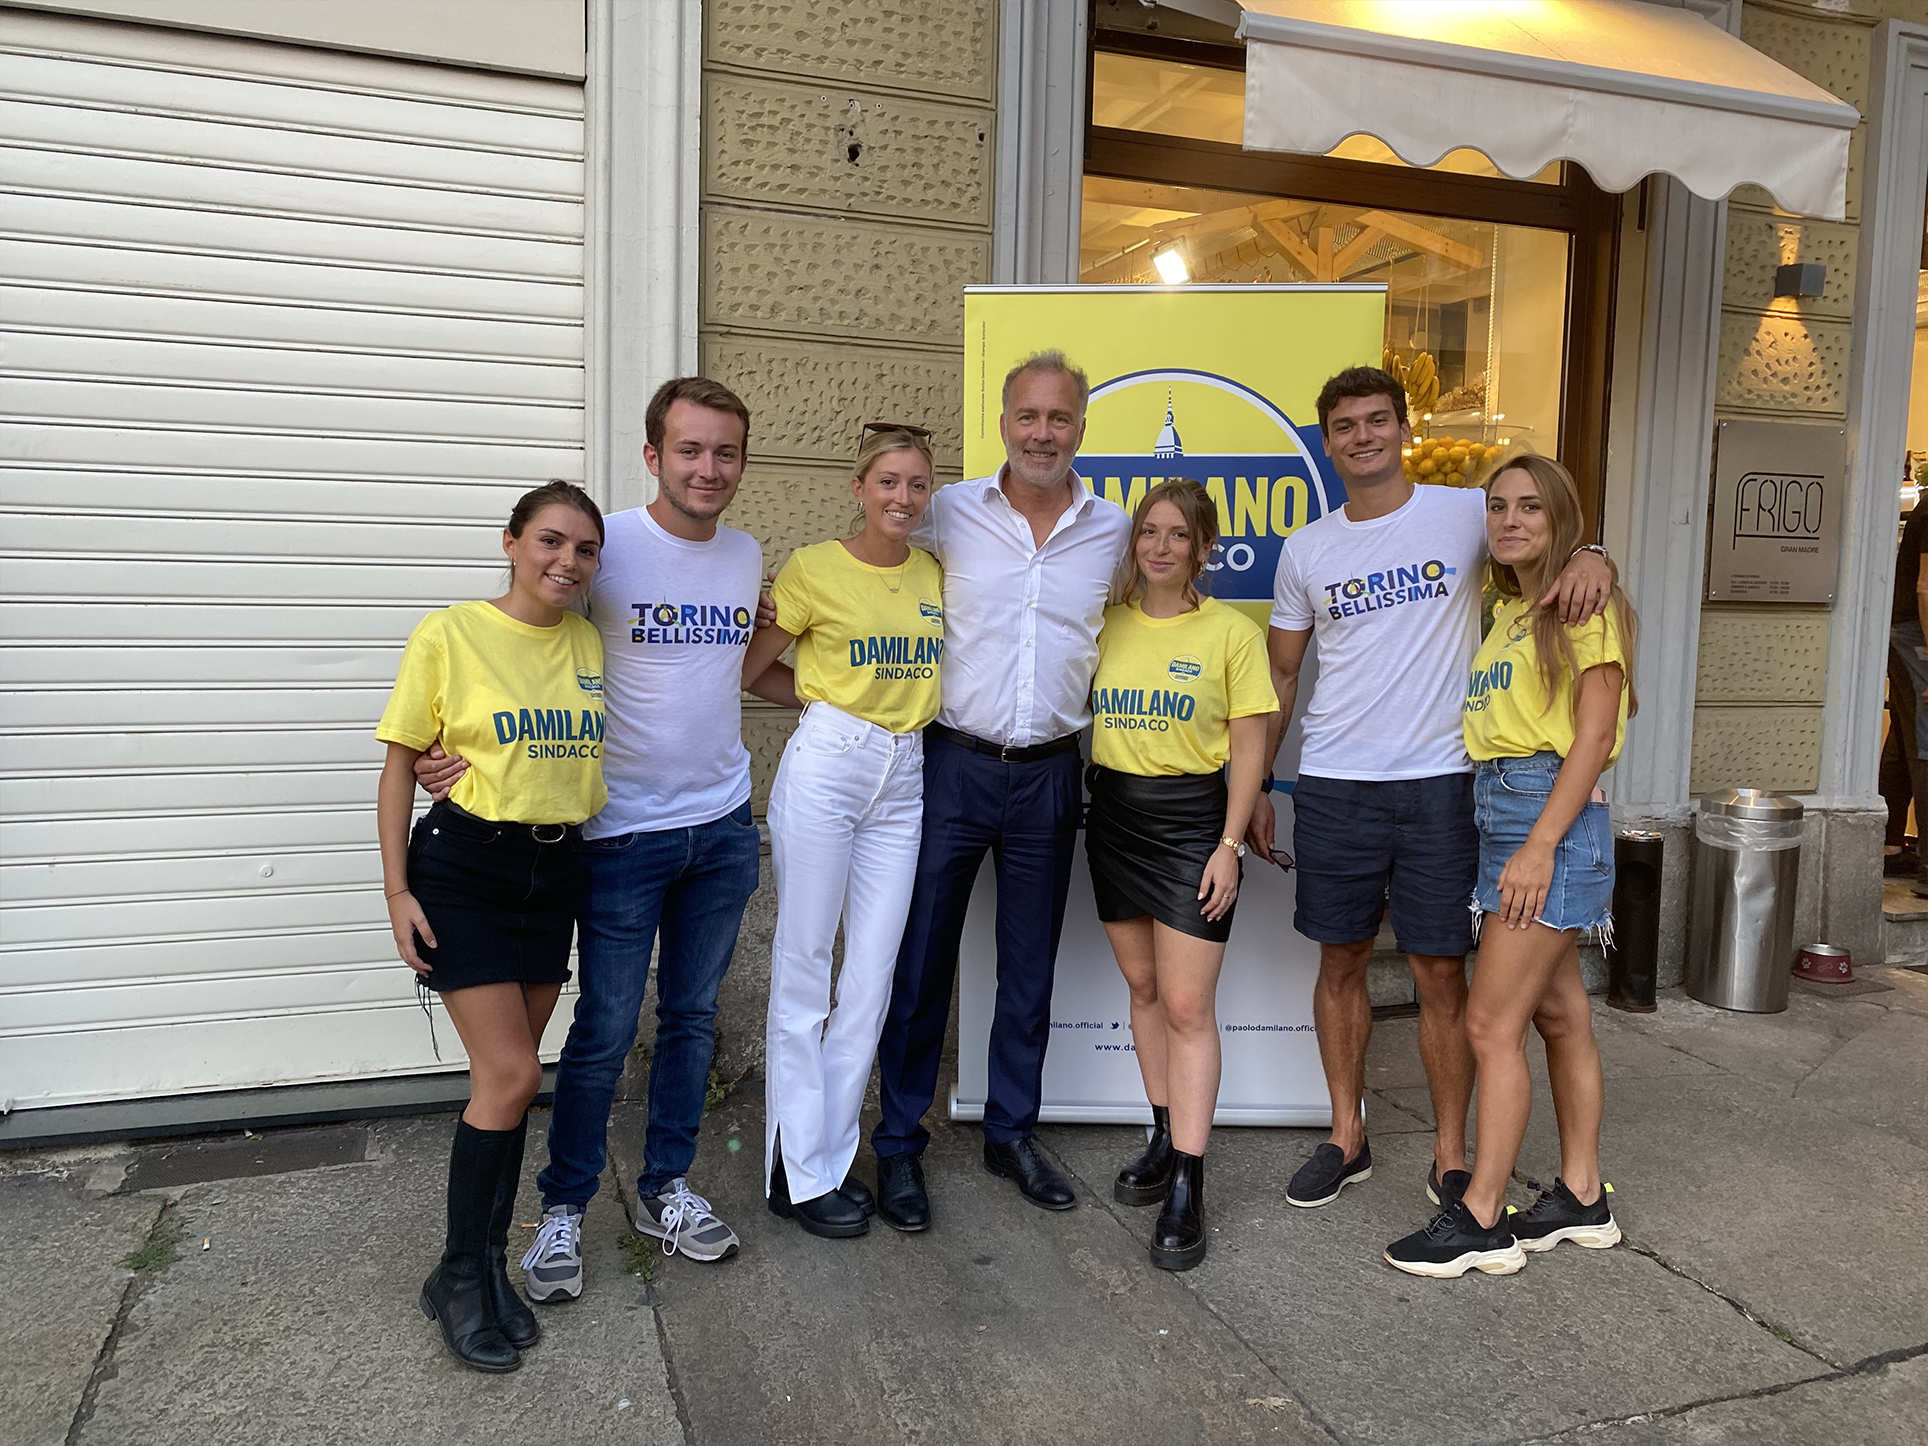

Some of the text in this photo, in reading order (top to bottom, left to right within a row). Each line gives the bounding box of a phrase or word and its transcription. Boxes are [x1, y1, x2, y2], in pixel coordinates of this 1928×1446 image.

[1080, 476, 1308, 538] MANO
[1738, 477, 1824, 534] FRIGO
[1780, 545, 1820, 554] GRAN MADRE
[1324, 559, 1447, 604] TORINO
[1328, 581, 1449, 620] BELLISSIMA
[631, 603, 751, 629] TORINO
[631, 627, 750, 646] BELLISSIMA
[874, 667, 933, 680] SINDACO
[492, 708, 606, 745] DAMILAN
[1104, 716, 1169, 732] SINDACO
[1225, 1023, 1316, 1033] @paolodamilano.offic
